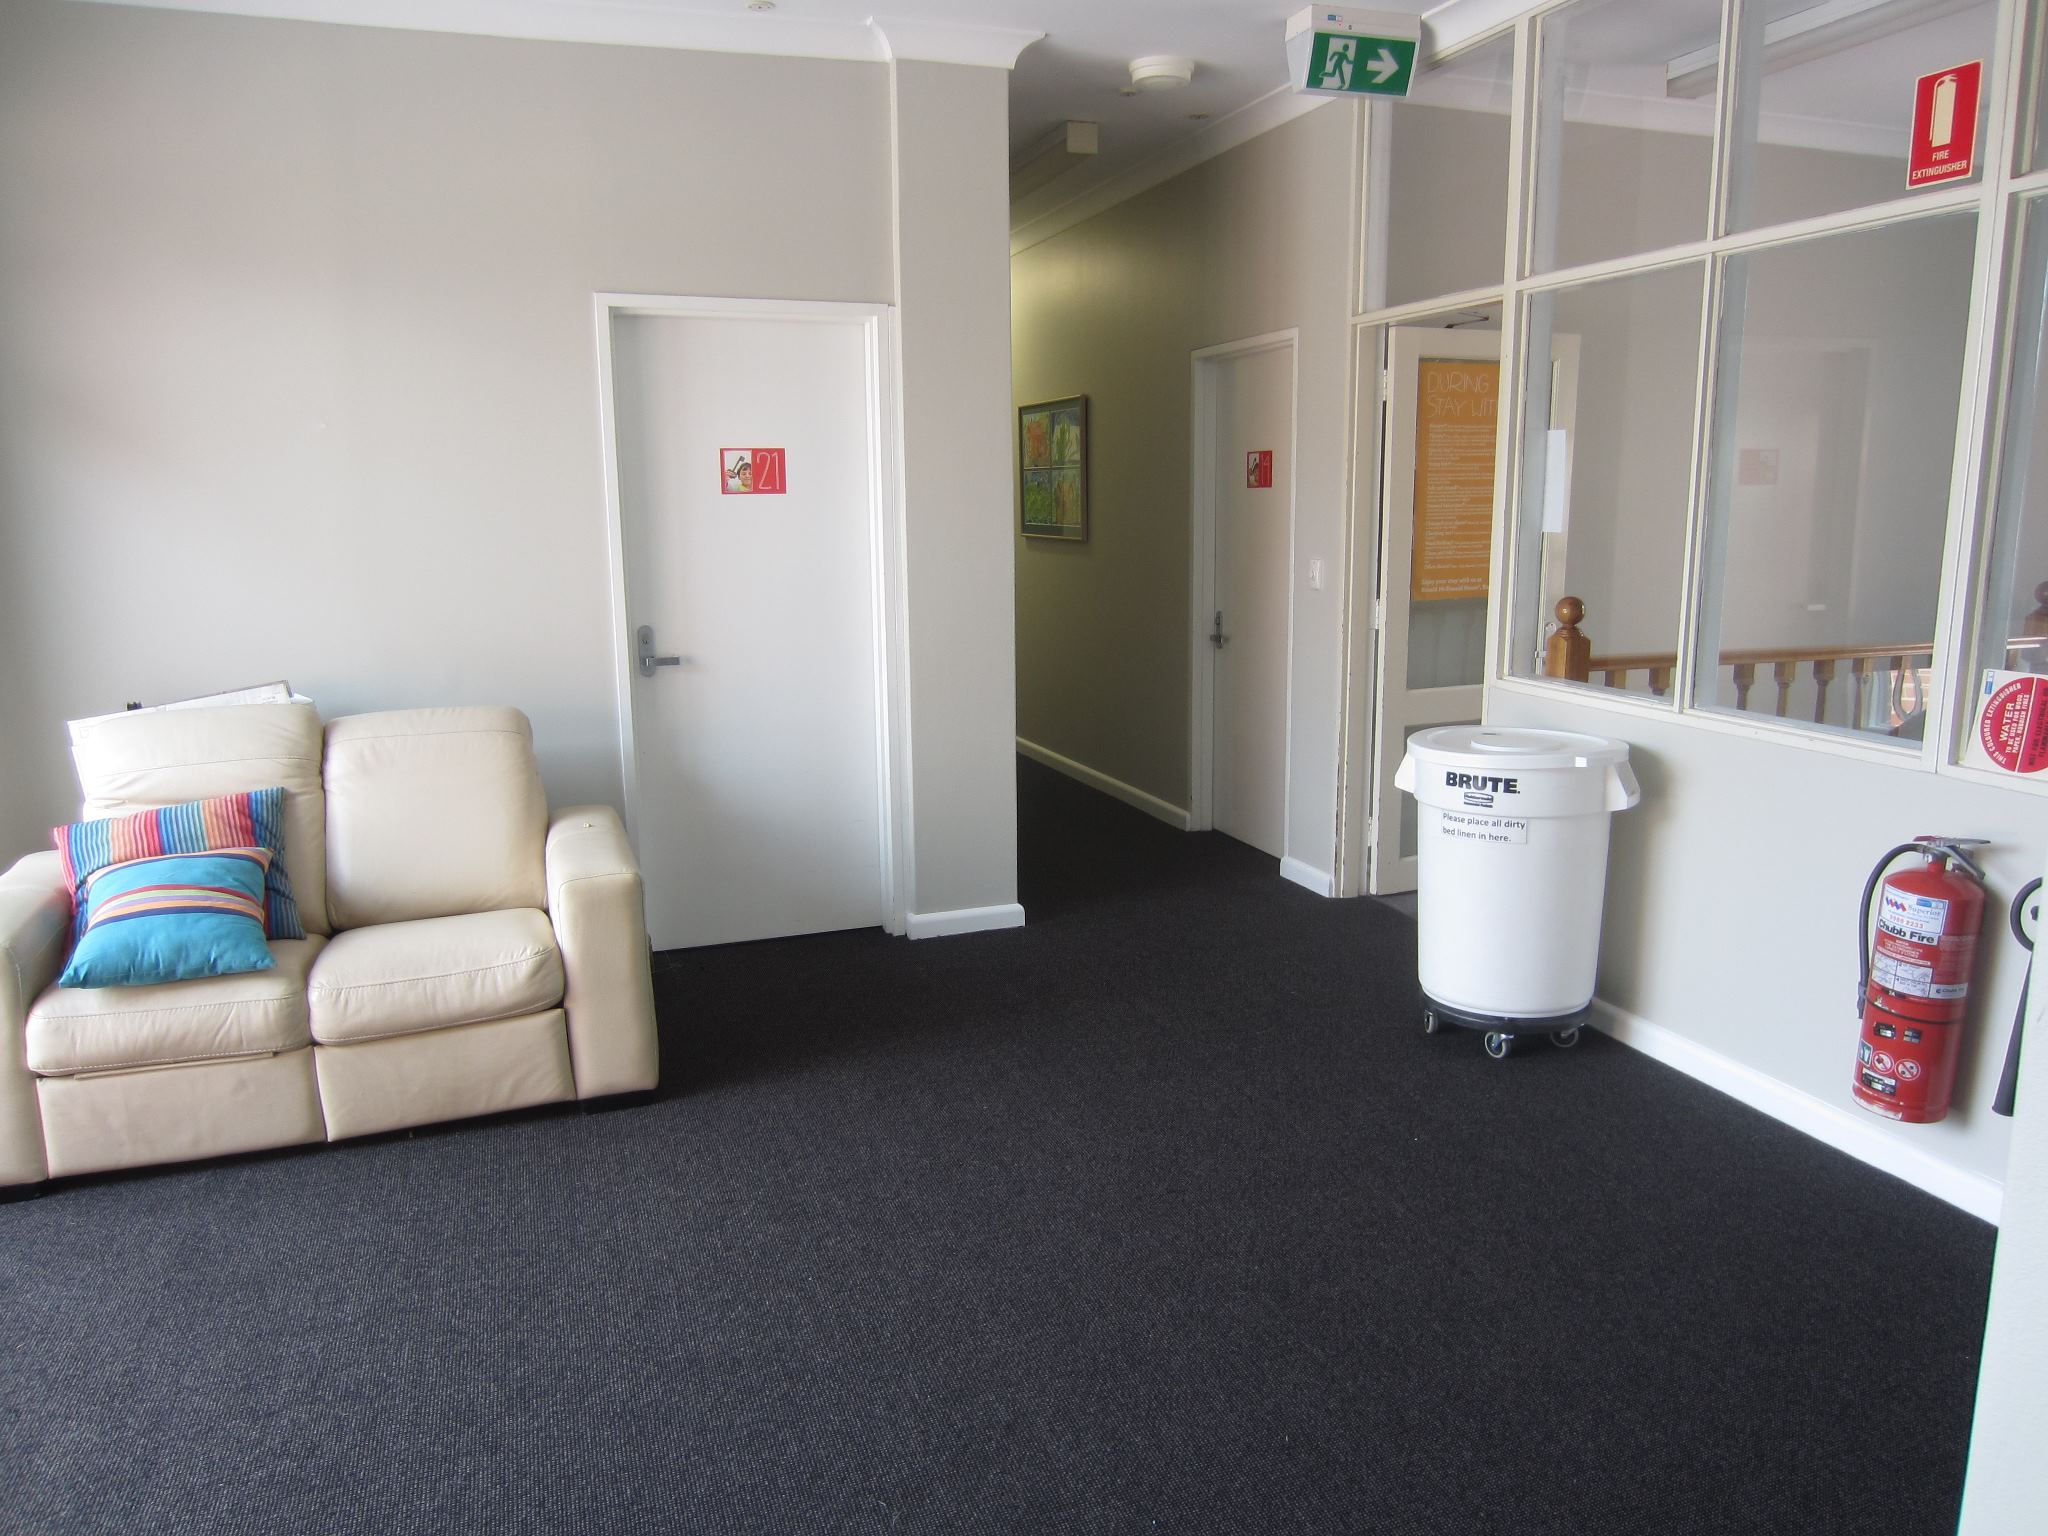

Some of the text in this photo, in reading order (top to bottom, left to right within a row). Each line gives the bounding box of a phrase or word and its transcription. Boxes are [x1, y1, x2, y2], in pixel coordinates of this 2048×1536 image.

[1932, 150, 1950, 162] FIRE
[1912, 160, 1967, 180] EXTINGUISHER
[1427, 371, 1489, 393] DURING
[1427, 397, 1497, 418] STAY WIT
[756, 451, 780, 490] 21
[1986, 682, 2022, 718] EXTINGUISHER
[1999, 702, 2015, 742] WATER
[1984, 719, 1996, 752] COLOURED
[1443, 812, 1526, 830] Please place all dirty
[1442, 826, 1512, 842] bed linen in here.
[1908, 904, 1941, 917] Superior
[1879, 919, 1906, 938] Chubb
[1909, 930, 1935, 944] Fire
